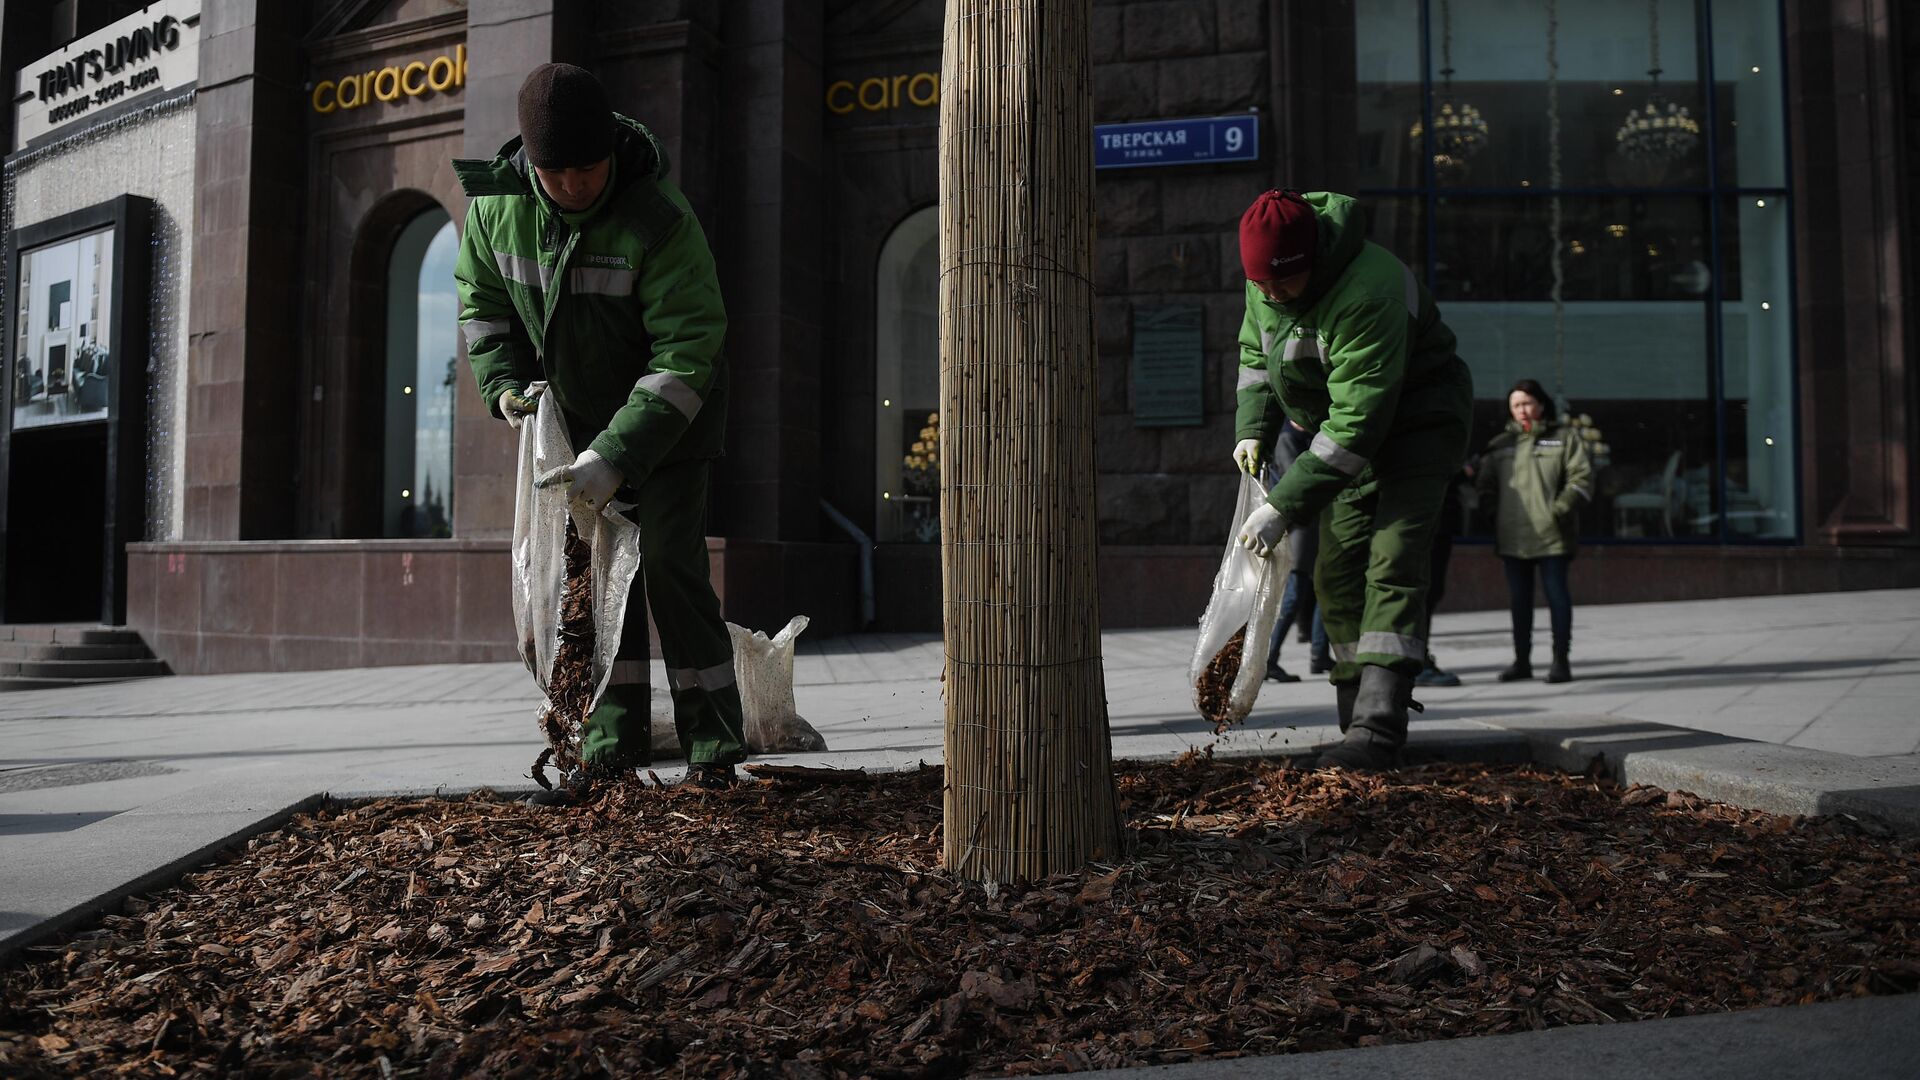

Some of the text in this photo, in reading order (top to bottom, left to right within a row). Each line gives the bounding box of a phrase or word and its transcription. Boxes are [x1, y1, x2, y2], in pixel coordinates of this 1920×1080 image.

[105, 15, 180, 76] LIVING
[312, 44, 468, 112] caracol
[1100, 130, 1187, 149] ТВЕРСКАЯ
[1225, 126, 1244, 152] 9
